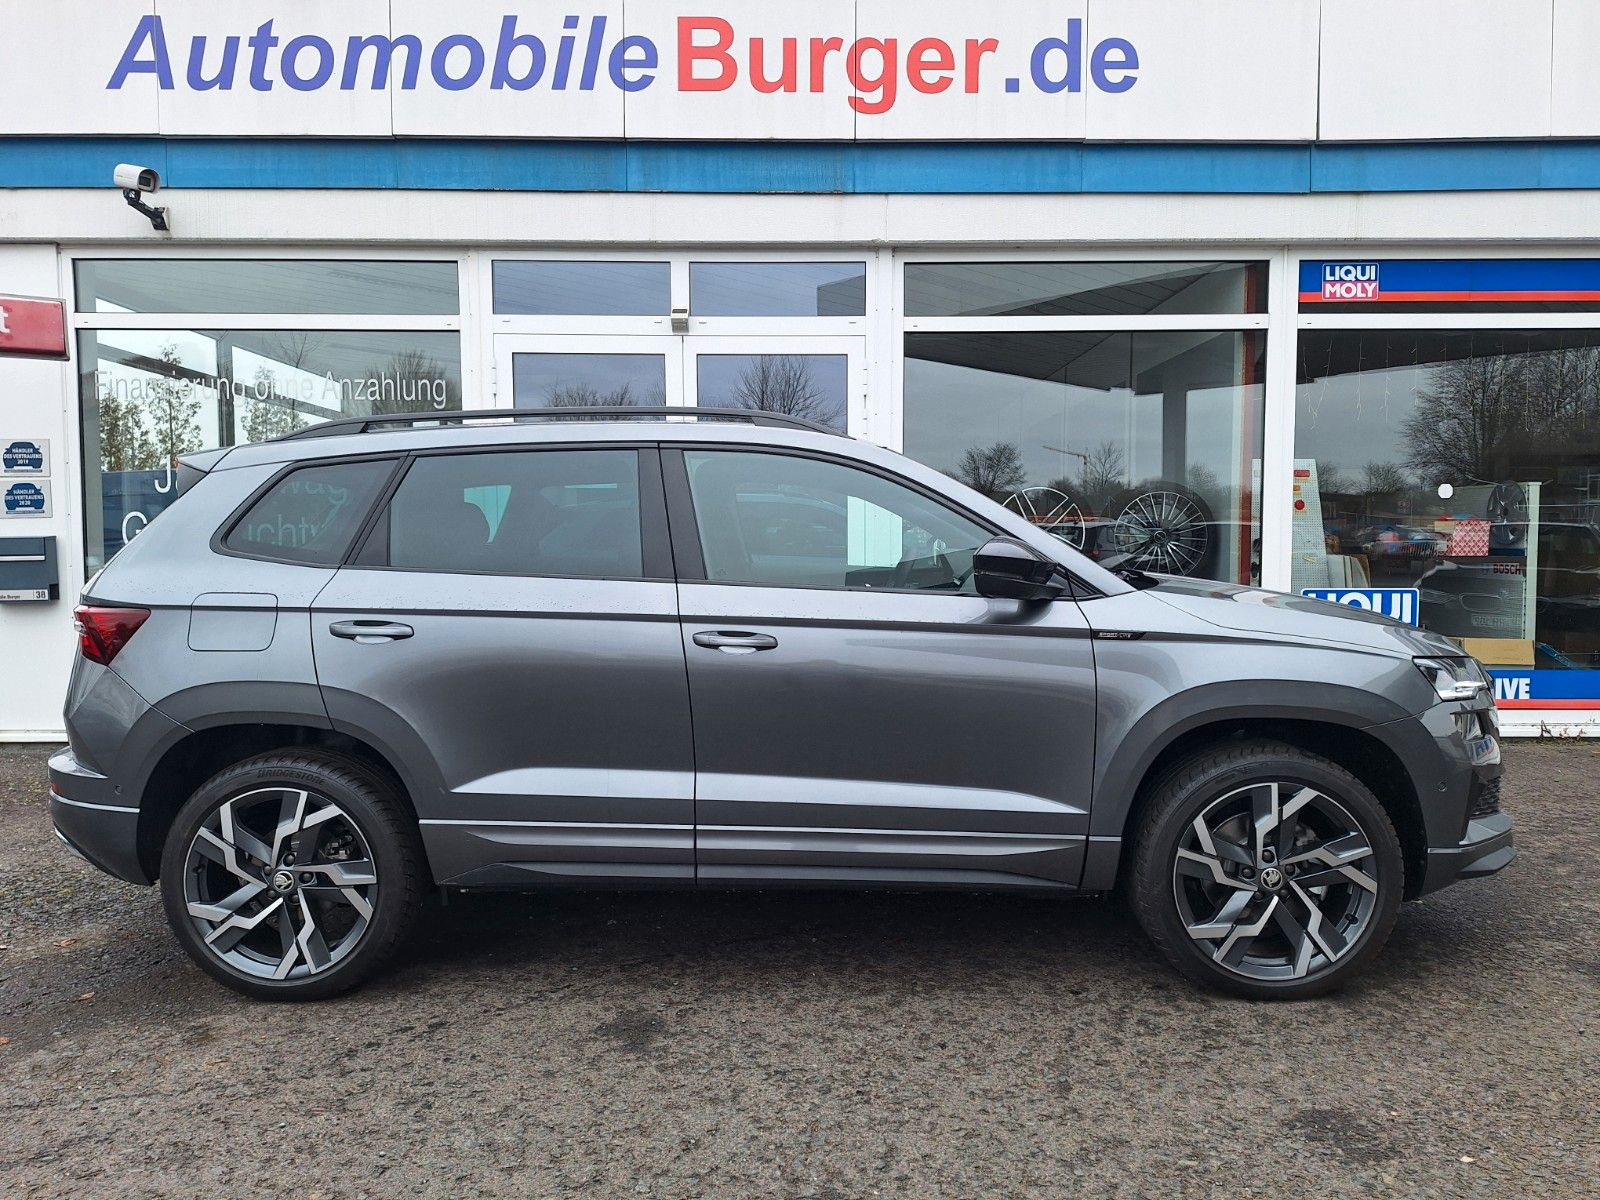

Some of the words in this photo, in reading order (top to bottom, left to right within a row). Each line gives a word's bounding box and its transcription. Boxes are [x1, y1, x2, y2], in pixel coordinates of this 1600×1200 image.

[1325, 264, 1376, 281] LIQUI
[1325, 282, 1377, 298] MOLY
[255, 371, 314, 400] ohne
[321, 371, 446, 409] Anzahlung
[1493, 562, 1521, 576] BOSCH
[35, 590, 46, 599] 38
[1495, 677, 1531, 700] IVE
